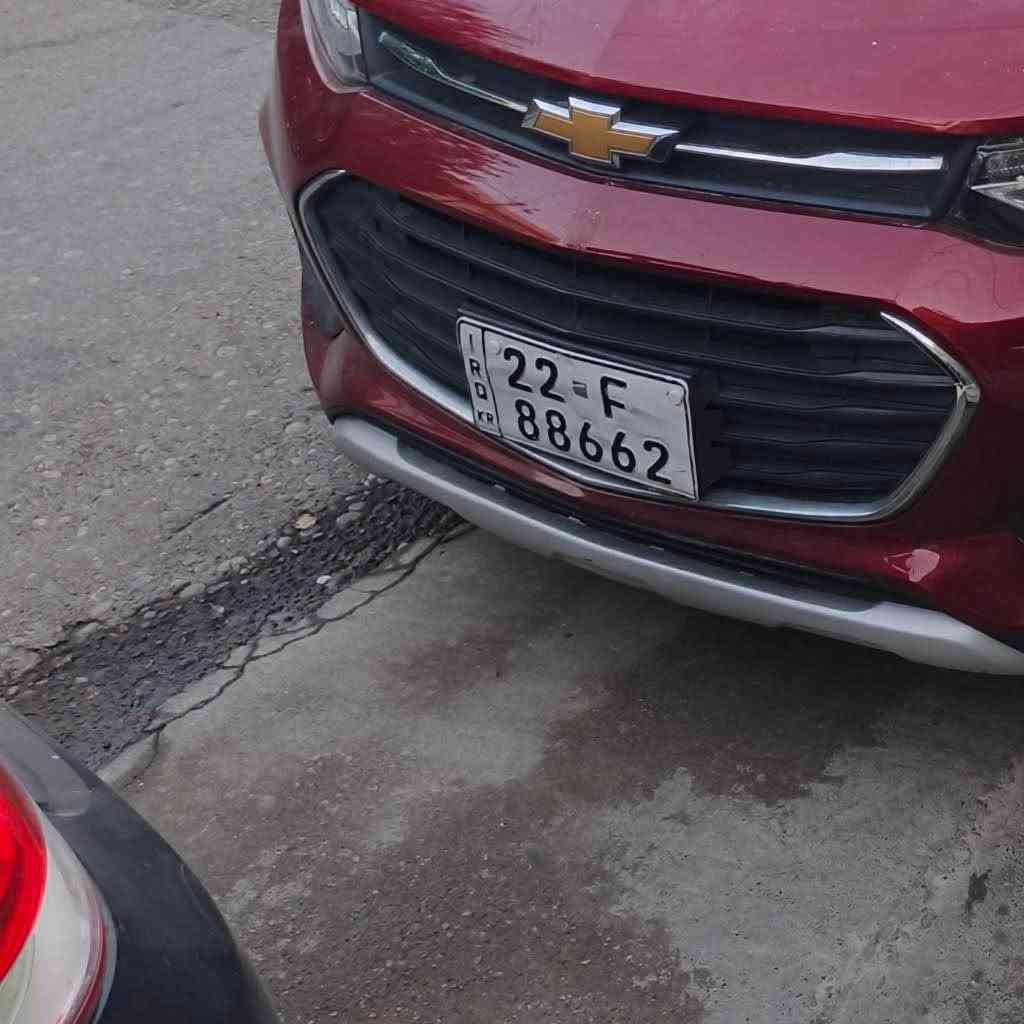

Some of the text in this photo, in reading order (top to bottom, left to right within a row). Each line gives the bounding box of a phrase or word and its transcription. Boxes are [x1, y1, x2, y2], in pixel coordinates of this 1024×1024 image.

[503, 347, 628, 419] 22 F
[514, 399, 672, 485] 88662
